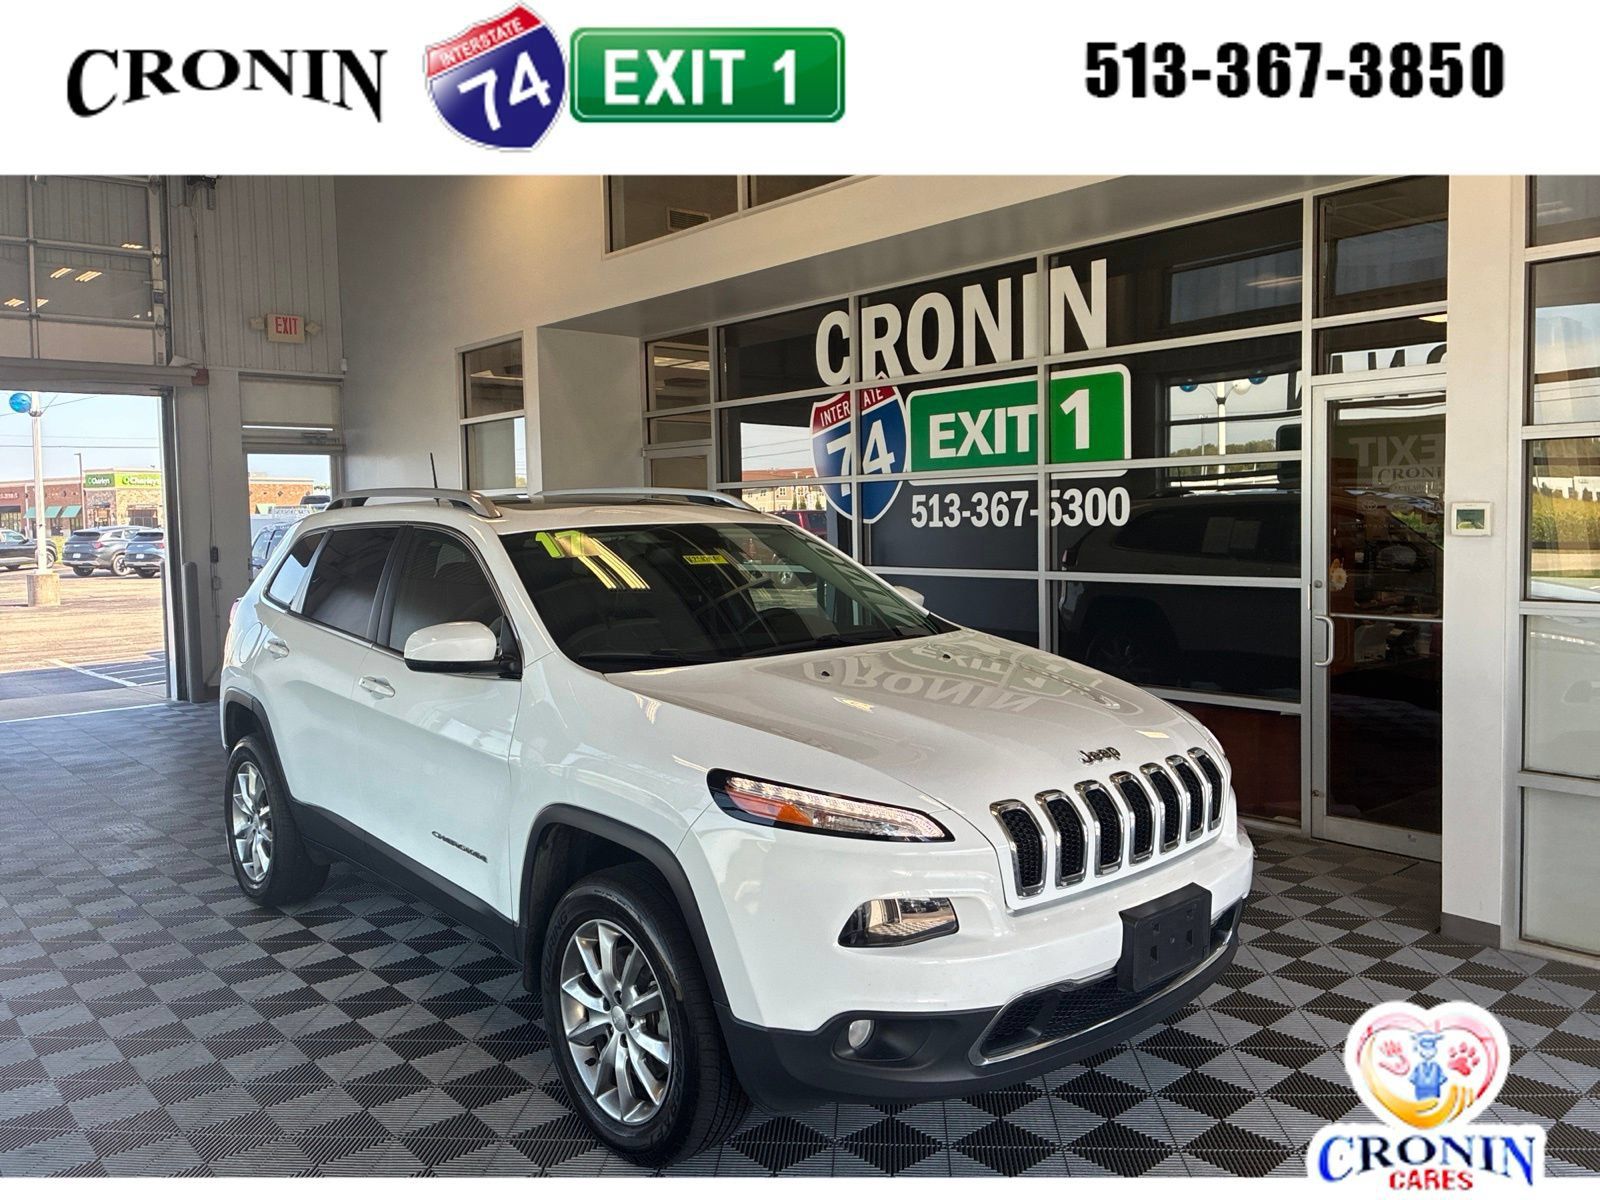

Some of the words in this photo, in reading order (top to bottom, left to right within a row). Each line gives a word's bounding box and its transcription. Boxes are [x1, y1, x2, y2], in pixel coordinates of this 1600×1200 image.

[275, 316, 299, 335] EXIT
[815, 258, 1107, 388] CRONIN
[820, 388, 884, 427] INTERATE
[929, 405, 1038, 459] EXIT
[1060, 388, 1090, 450] 1
[826, 419, 896, 497] 74
[1079, 747, 1121, 764] Jeep
